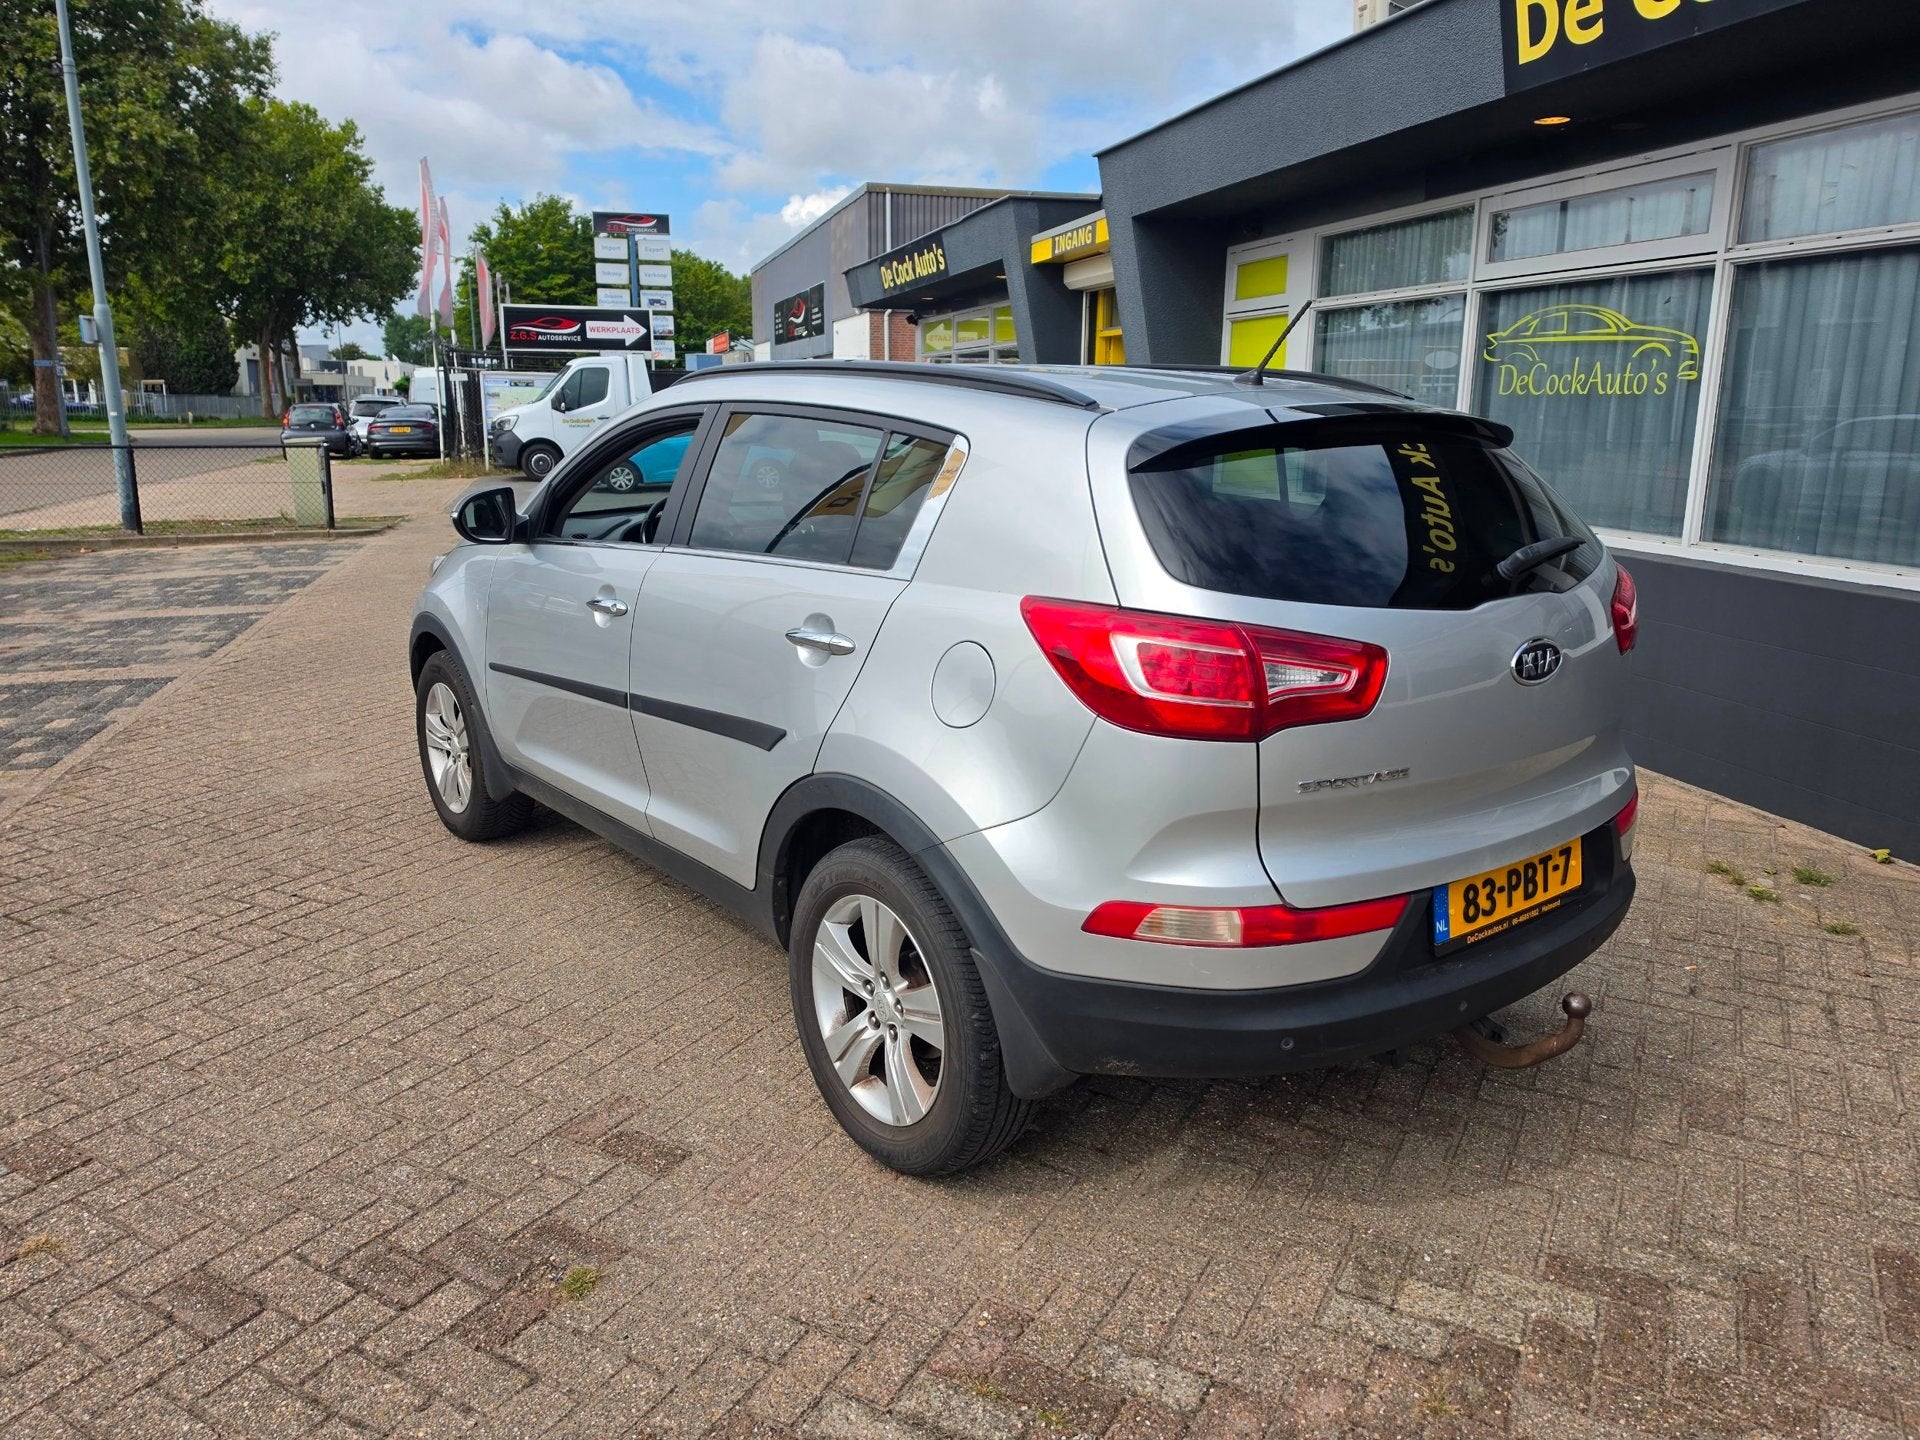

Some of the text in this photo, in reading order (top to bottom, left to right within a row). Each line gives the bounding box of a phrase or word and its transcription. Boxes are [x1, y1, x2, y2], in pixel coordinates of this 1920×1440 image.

[1054, 225, 1093, 254] INGANG
[880, 243, 945, 289] De Cock Auto's
[510, 331, 538, 341] Z.G.S
[588, 326, 641, 334] WERKPLAATS
[1498, 356, 1668, 396] DeCockAuto's
[1463, 846, 1572, 924] 83-PBT-7
[1436, 919, 1448, 933] NL
